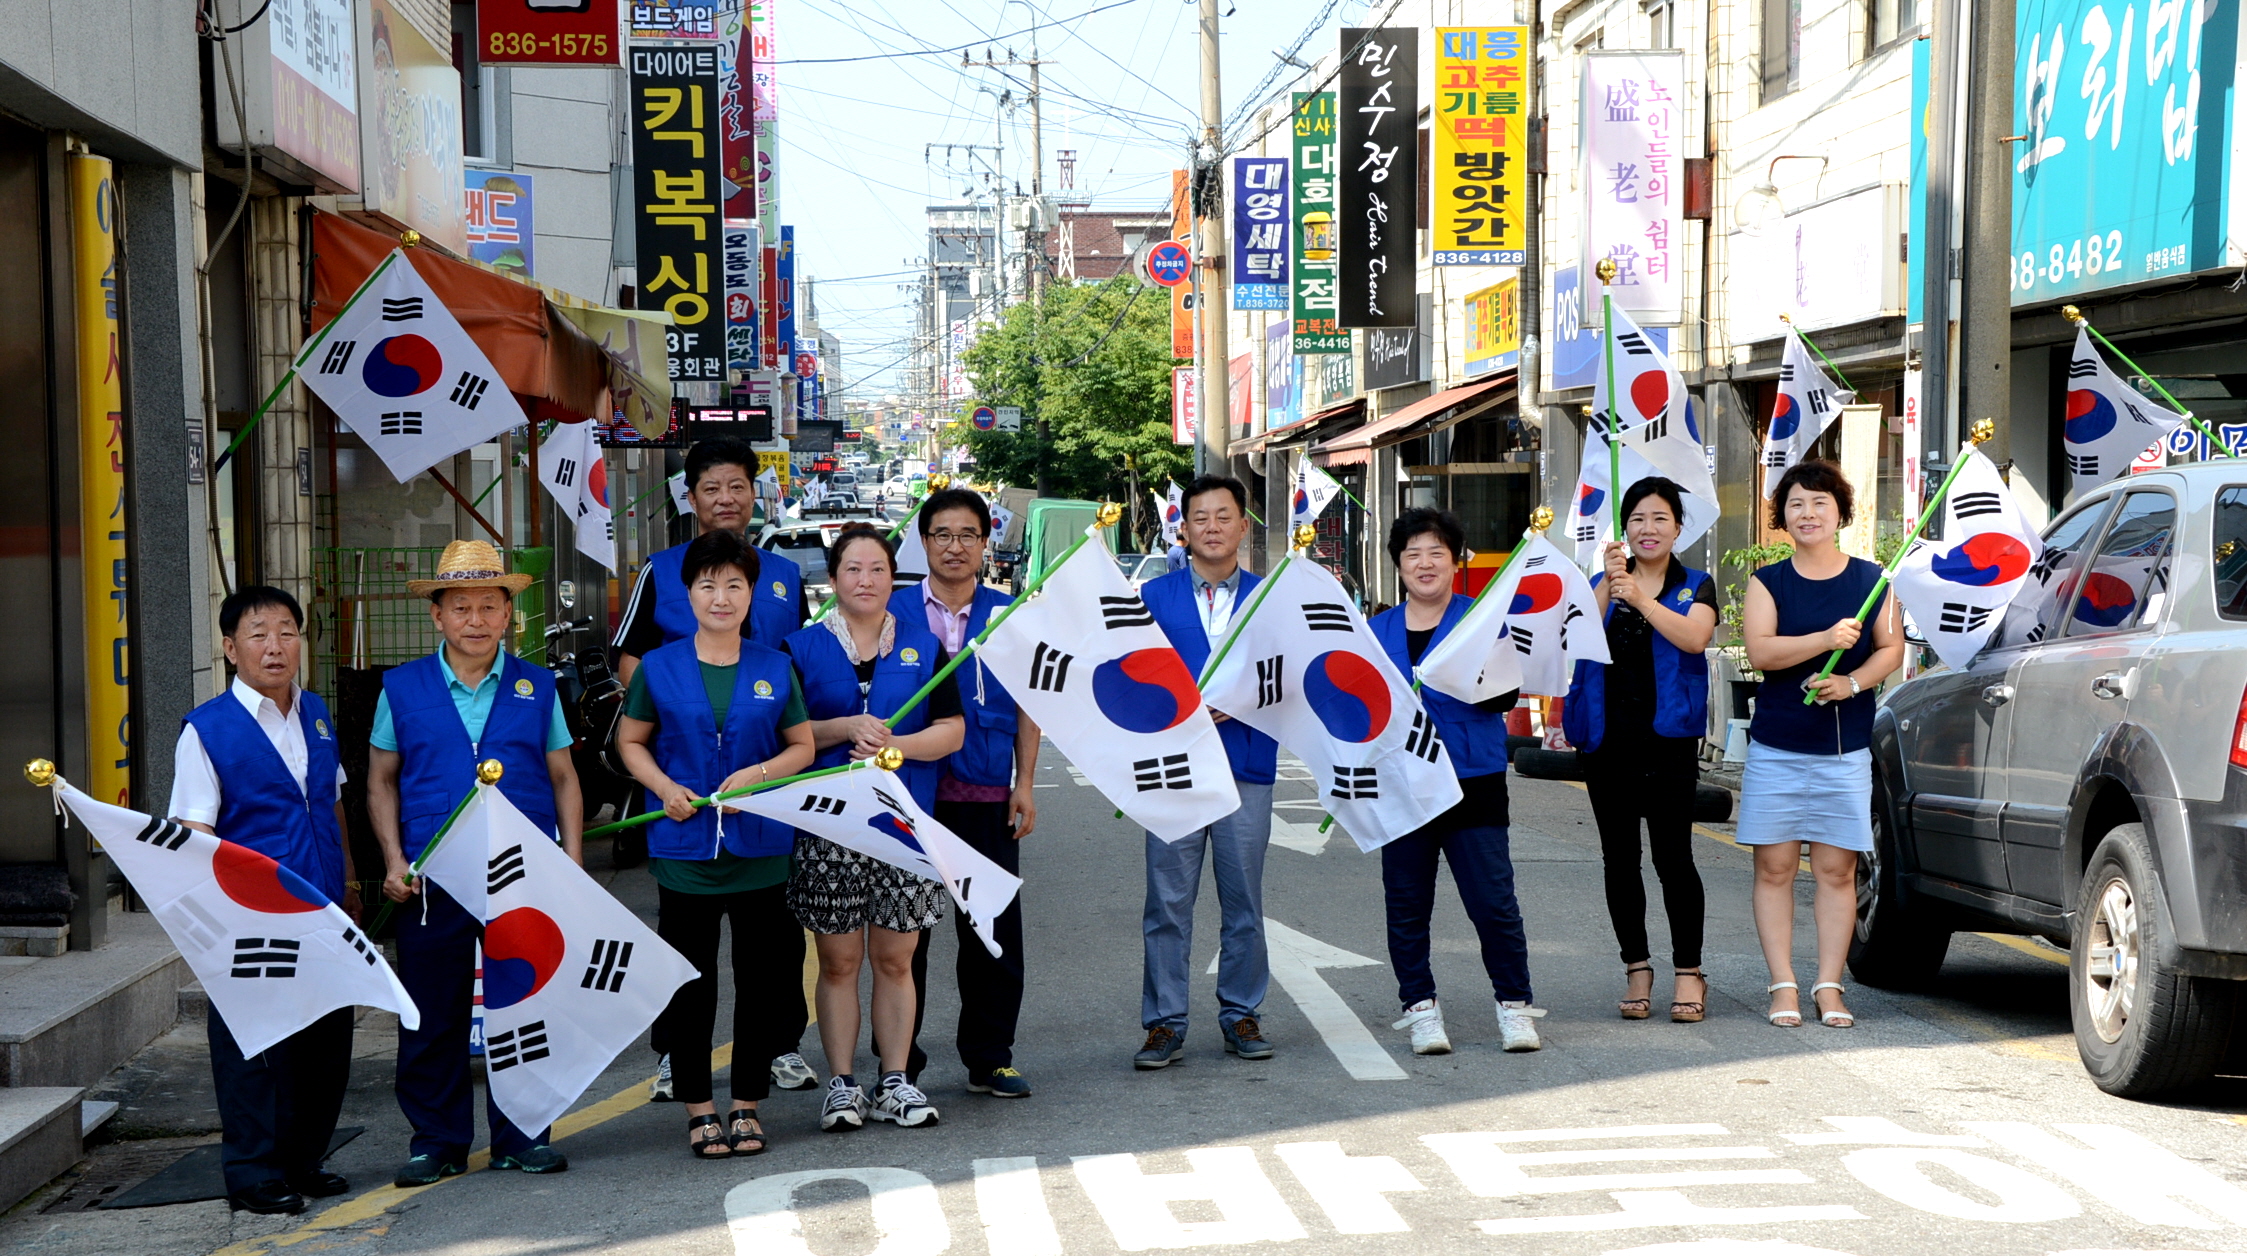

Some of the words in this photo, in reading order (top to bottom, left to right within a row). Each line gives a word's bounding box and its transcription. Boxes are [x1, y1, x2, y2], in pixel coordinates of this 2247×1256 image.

[632, 5, 714, 33] 보드게임
[489, 31, 608, 56] 836-1575
[1443, 31, 1521, 62] 대흥
[633, 51, 715, 77] 다이어트
[1441, 65, 1521, 89] 고추
[2016, 0, 2201, 174] 보리밥
[1358, 40, 1399, 185] 민수정
[1443, 92, 1521, 116] 기름
[1294, 117, 1338, 137] 신사
[1644, 79, 1673, 207] 노인들의
[1604, 78, 1640, 287] 盛老堂
[643, 84, 715, 325] 킥복싱
[1244, 163, 1286, 281] 대영세탁
[1368, 191, 1389, 250] Hair
[724, 233, 752, 289] 오동도
[1155, 259, 1184, 269] 주정차금지
[1434, 252, 1523, 264] 836-4128
[1643, 218, 1670, 284] 쉼터
[1236, 286, 1289, 298] 수선전문
[1368, 255, 1388, 316] Trend
[730, 296, 750, 320] 회
[1556, 286, 1579, 342] POS
[666, 332, 699, 353] 3F
[1294, 337, 1350, 350] 36-4416
